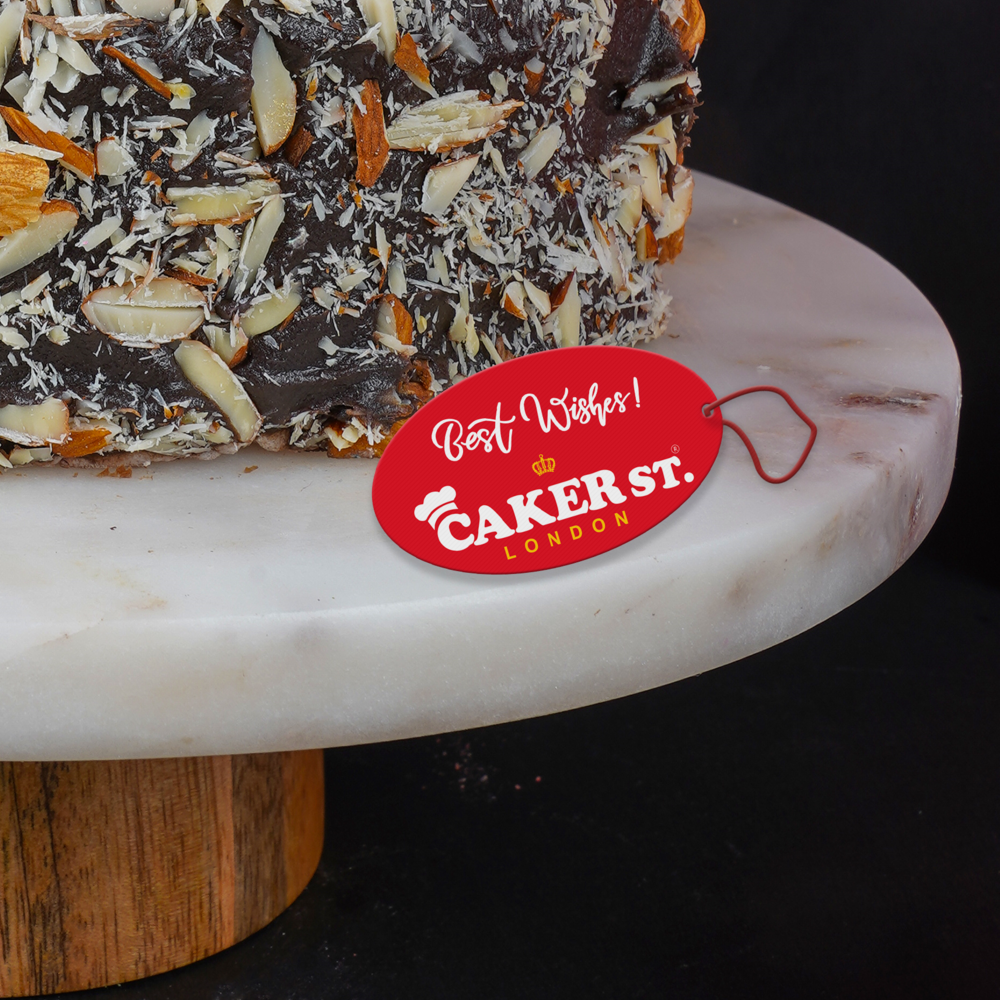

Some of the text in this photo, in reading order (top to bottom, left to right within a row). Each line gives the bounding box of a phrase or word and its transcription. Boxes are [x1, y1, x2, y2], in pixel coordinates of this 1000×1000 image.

[431, 377, 642, 462] Best Wishes!
[434, 469, 627, 551] CAKER
[504, 510, 629, 560] LONDON
